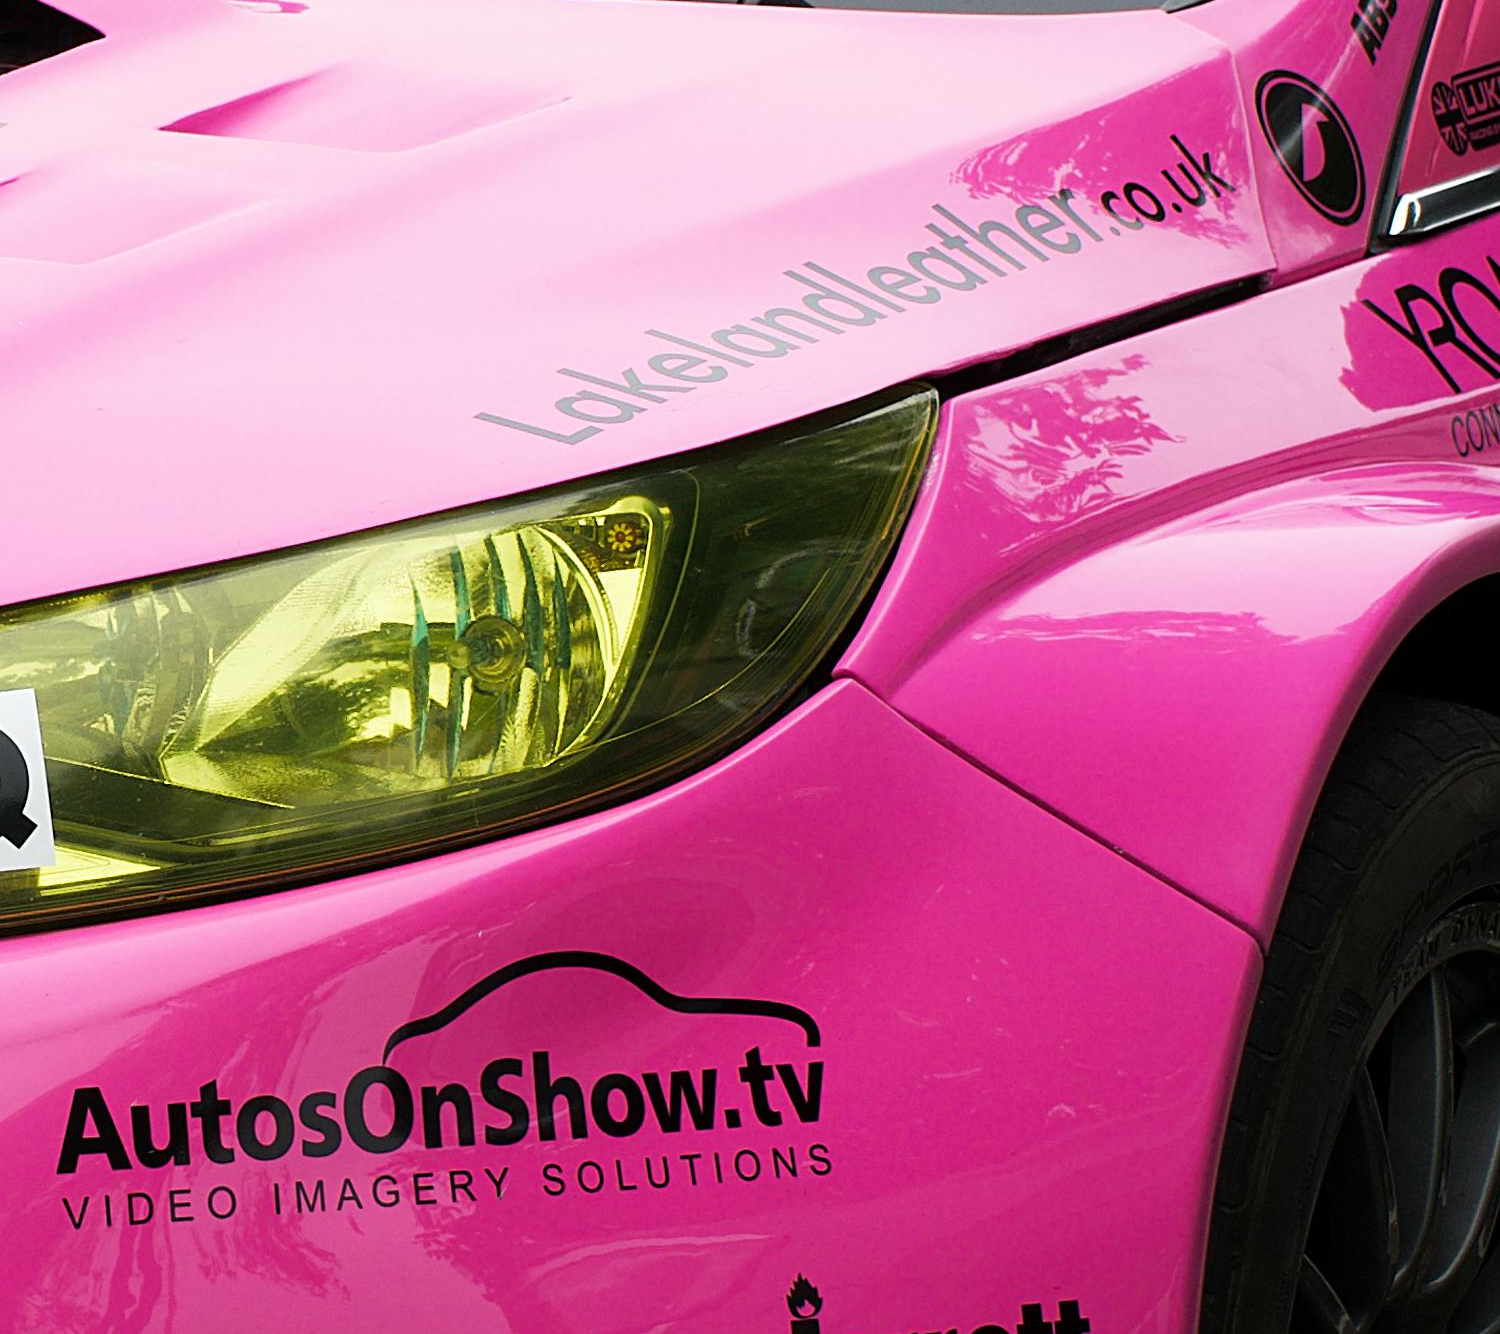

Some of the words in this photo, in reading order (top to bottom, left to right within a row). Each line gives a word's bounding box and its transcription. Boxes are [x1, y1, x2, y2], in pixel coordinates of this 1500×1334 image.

[474, 134, 1236, 447] Lakelandleather.co.uk
[55, 1046, 825, 1175] AutosOnShow.tv
[61, 1185, 239, 1231] VIDEO
[272, 1167, 511, 1217] IMAGERY
[542, 1143, 835, 1198] SOLUTIONS
